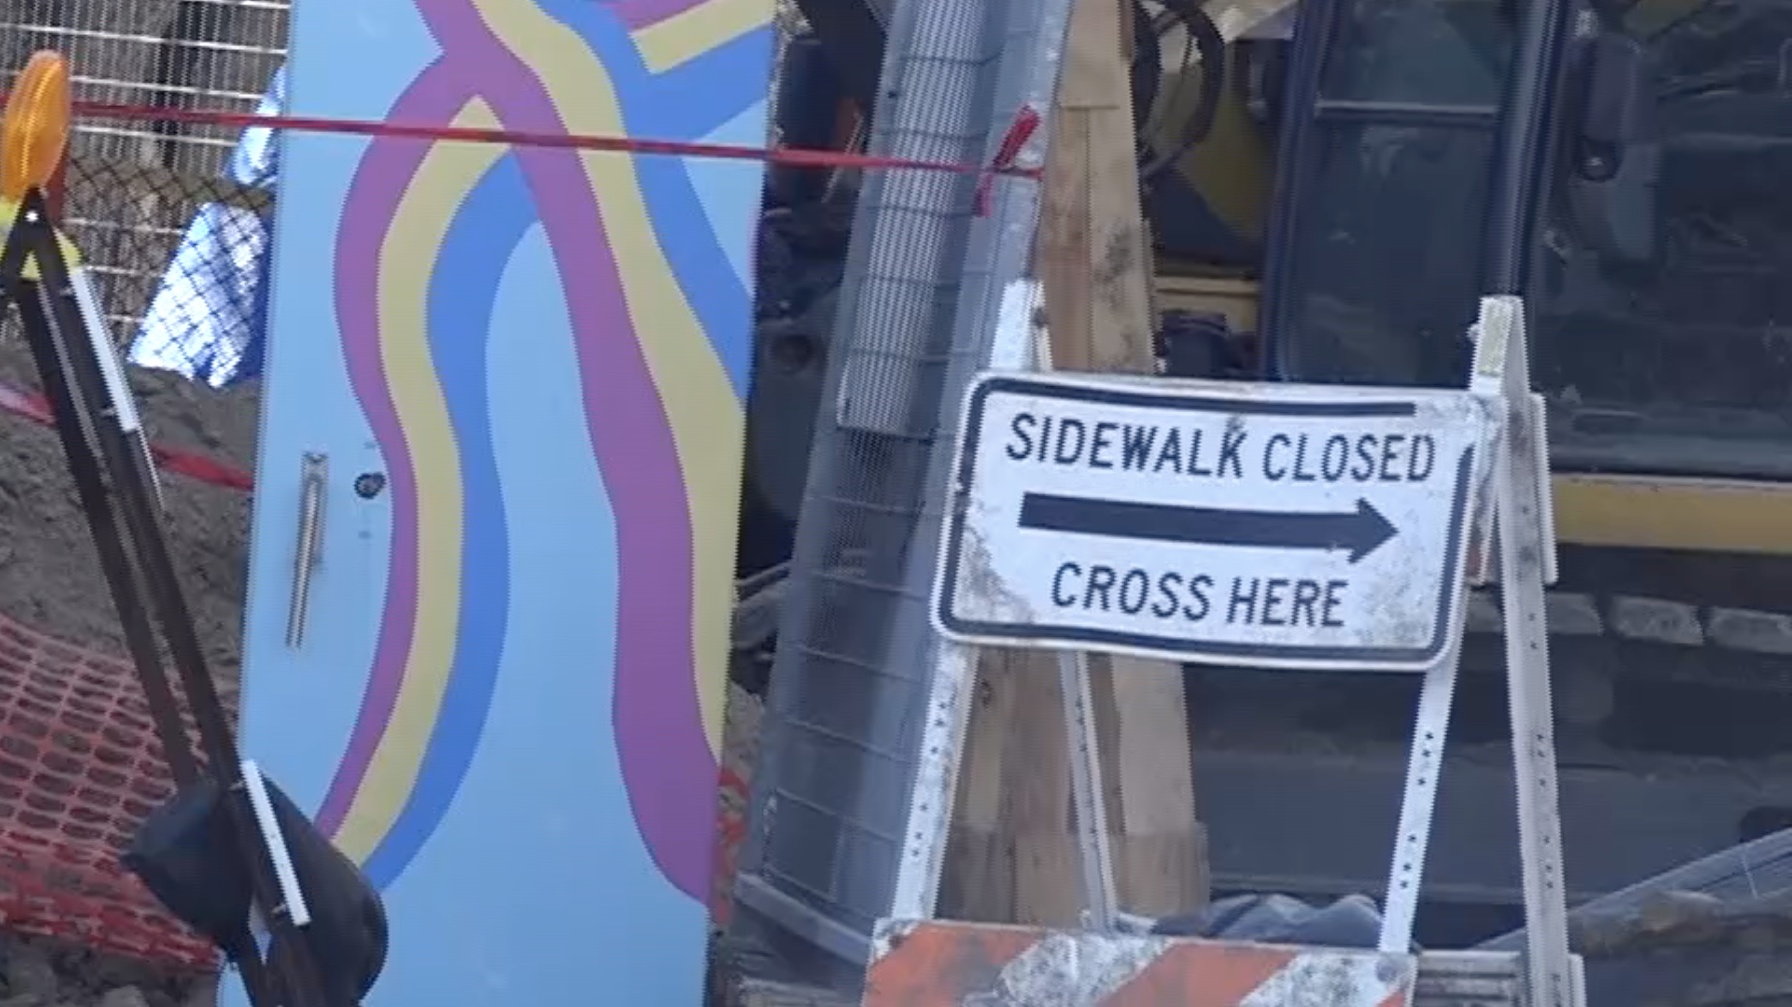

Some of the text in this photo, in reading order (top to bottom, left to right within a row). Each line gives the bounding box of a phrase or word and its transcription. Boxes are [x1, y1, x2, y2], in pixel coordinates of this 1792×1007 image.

[1005, 413, 1436, 483] SIDEWALK CLOSED
[1051, 561, 1349, 628] CROSS HERE
